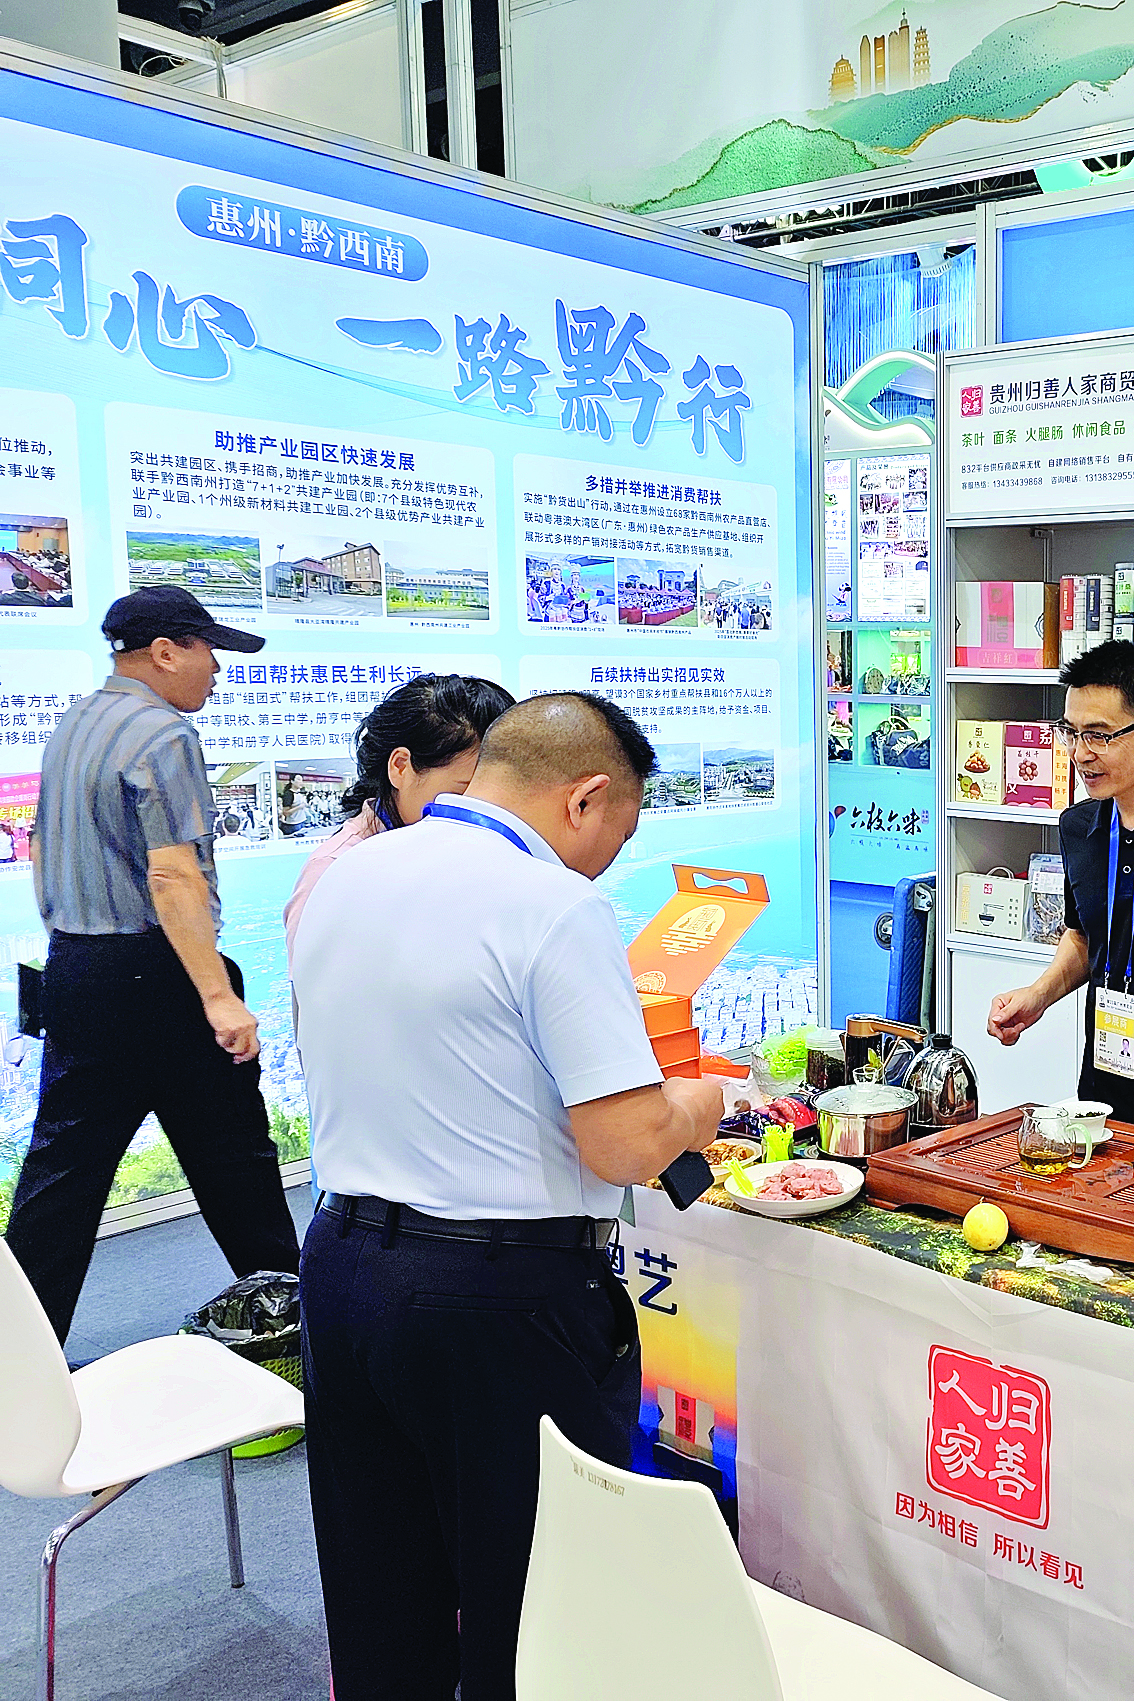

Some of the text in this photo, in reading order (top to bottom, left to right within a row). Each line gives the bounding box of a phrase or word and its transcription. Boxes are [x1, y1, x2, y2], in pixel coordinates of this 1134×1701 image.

[206, 196, 405, 274] 惠州·黔西南
[335, 297, 752, 464] 一路黔行
[988, 403, 1023, 415] GUIZHOU
[1025, 398, 1090, 412] GUISHANRENJIA
[961, 433, 985, 447] 茶叶
[993, 430, 1017, 445] 面条
[1025, 425, 1063, 443] 火腿肠
[1072, 420, 1126, 439] 休闲食品
[214, 430, 415, 472] 助推产业园区快速发展
[585, 474, 722, 506] 多措并举推进消费帮扶
[226, 664, 423, 685] 组团帮扶惠民生利长远
[590, 666, 726, 684] 后续扶持出实招见实效
[199, 733, 352, 750] 中学和册亨人民医院）取得
[895, 1491, 1085, 1590] 因为相信 所以看见
